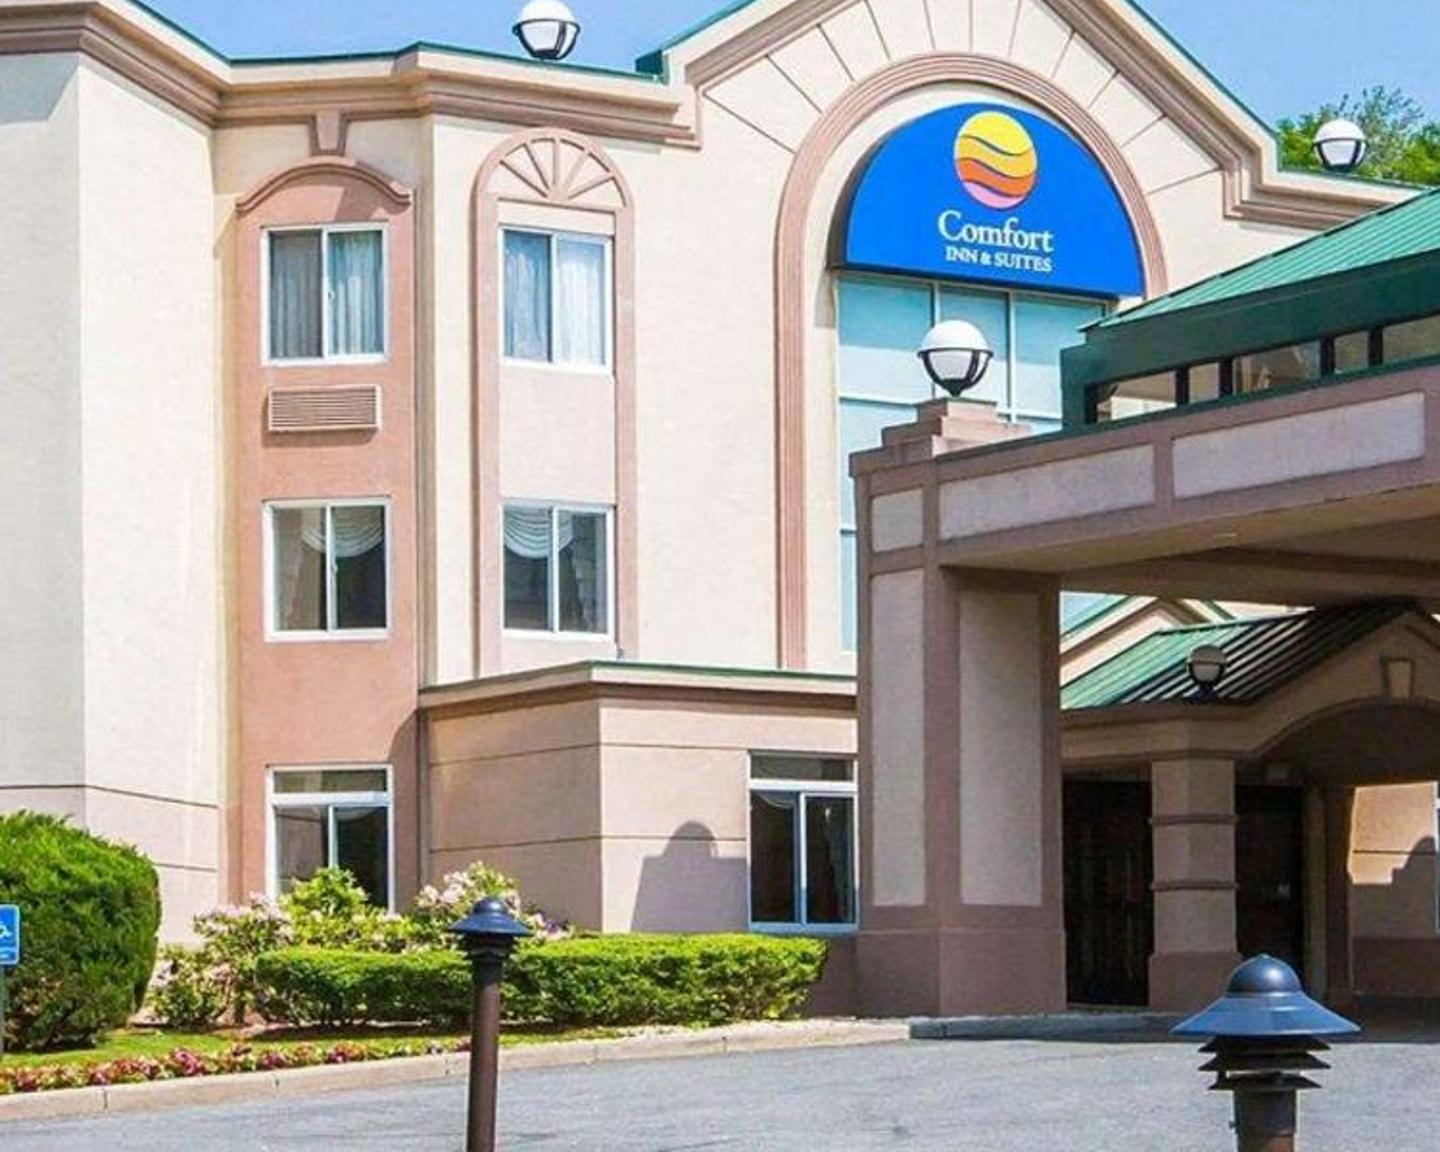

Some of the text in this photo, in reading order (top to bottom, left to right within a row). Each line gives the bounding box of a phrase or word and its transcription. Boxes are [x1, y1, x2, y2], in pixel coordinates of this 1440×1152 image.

[938, 209, 1054, 252] Comfort
[946, 246, 1052, 271] INN & SUITES
